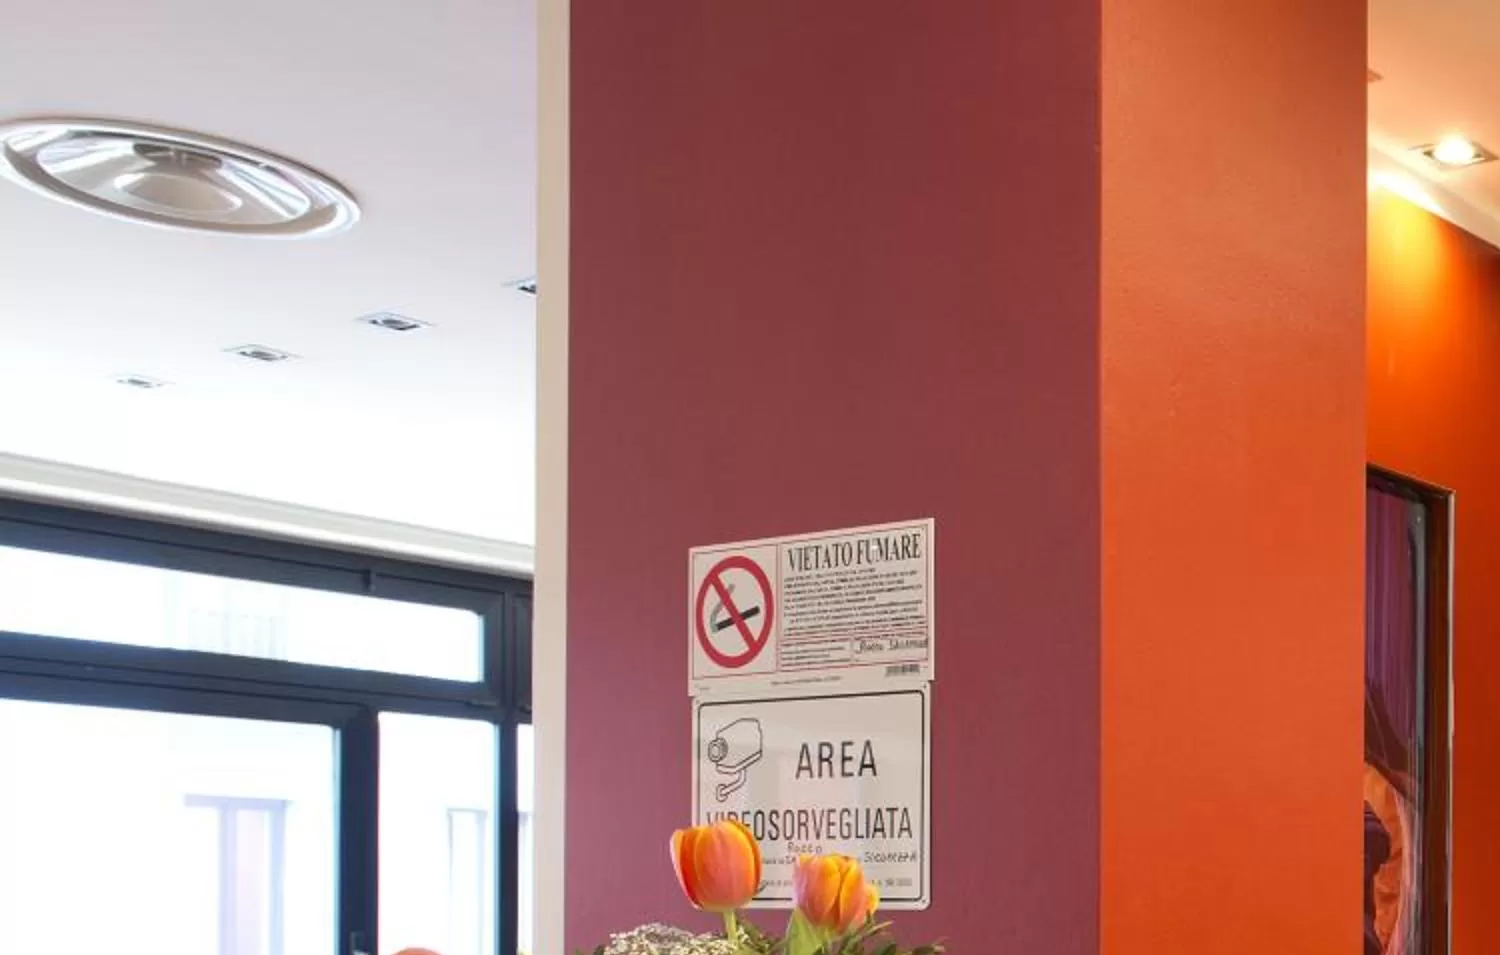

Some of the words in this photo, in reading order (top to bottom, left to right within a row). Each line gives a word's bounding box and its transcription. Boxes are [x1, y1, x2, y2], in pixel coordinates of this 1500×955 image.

[787, 541, 853, 572] VIETATO
[856, 533, 921, 565] FUMARE
[795, 739, 878, 779] AREA
[706, 806, 914, 842] EOSORVEGLIATA
